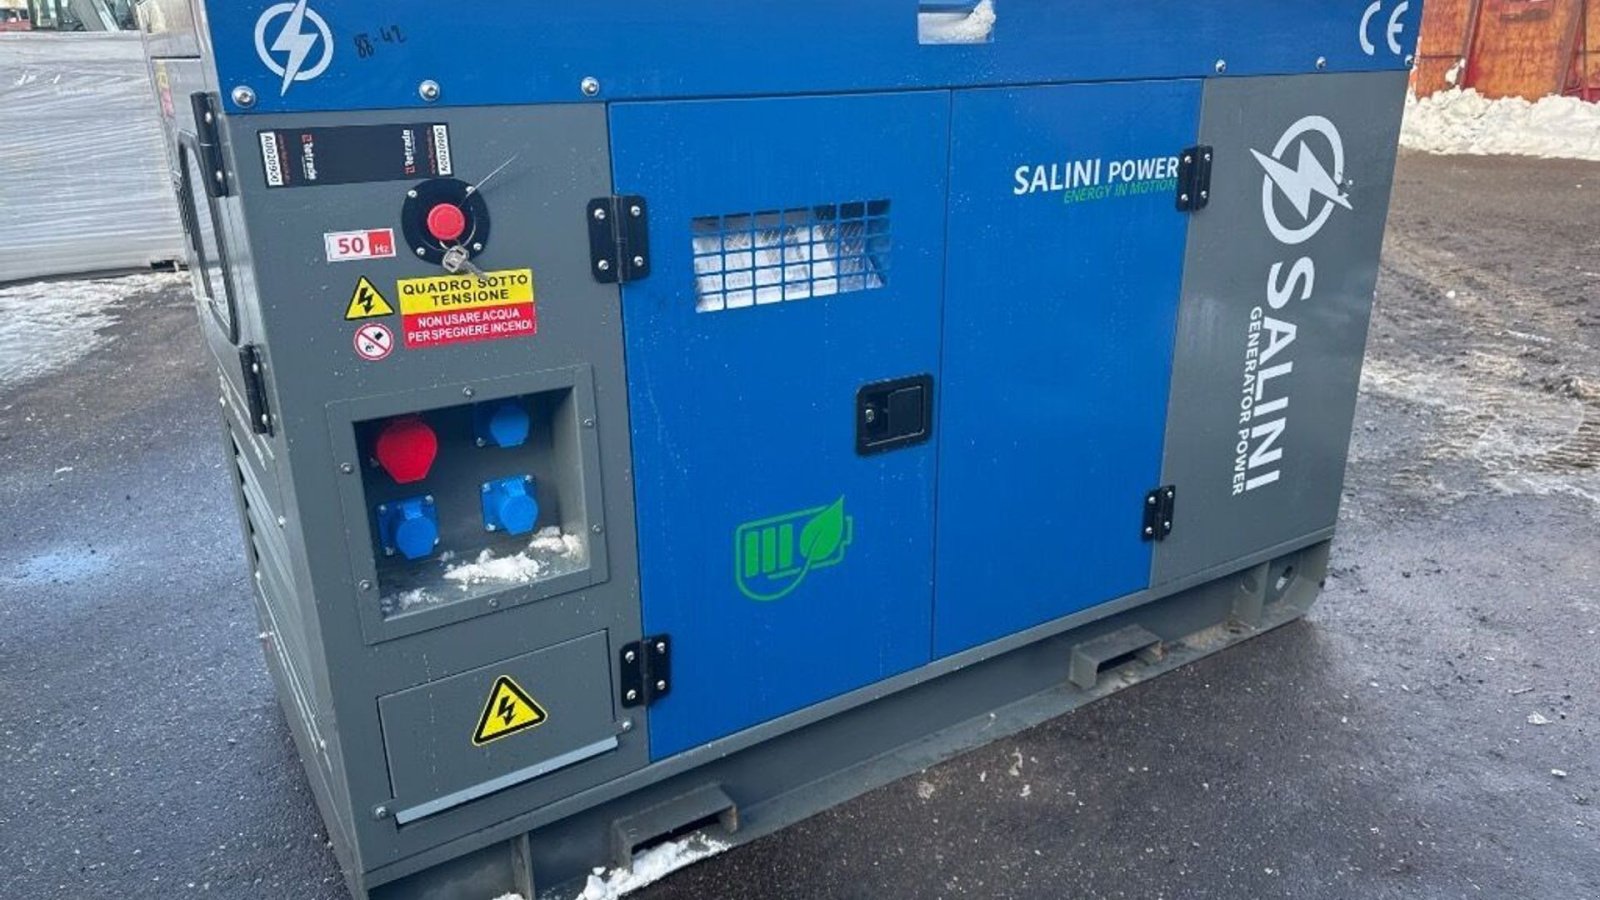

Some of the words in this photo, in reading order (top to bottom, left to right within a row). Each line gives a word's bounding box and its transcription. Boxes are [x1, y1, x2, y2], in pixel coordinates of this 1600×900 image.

[1013, 158, 1101, 195] SALINI
[1108, 156, 1179, 183] POWER
[1064, 186, 1112, 204] ENERGY
[1115, 185, 1126, 197] IN
[1130, 179, 1177, 194] MOTION
[338, 237, 364, 254] 50
[374, 244, 390, 254] Hz
[403, 279, 472, 295] QUADRO
[477, 274, 528, 288] SOTTO
[432, 289, 510, 306] TENSIONE
[418, 316, 443, 328] NON
[443, 312, 482, 326] USARE
[483, 308, 520, 321] ACQUA
[407, 330, 431, 343] PER
[431, 325, 491, 340] SPEGNERE
[491, 319, 533, 332] INCENDI
[1238, 306, 1263, 425] GENERATOR
[1246, 256, 1315, 491] SALINI
[1232, 427, 1250, 496] POWER
